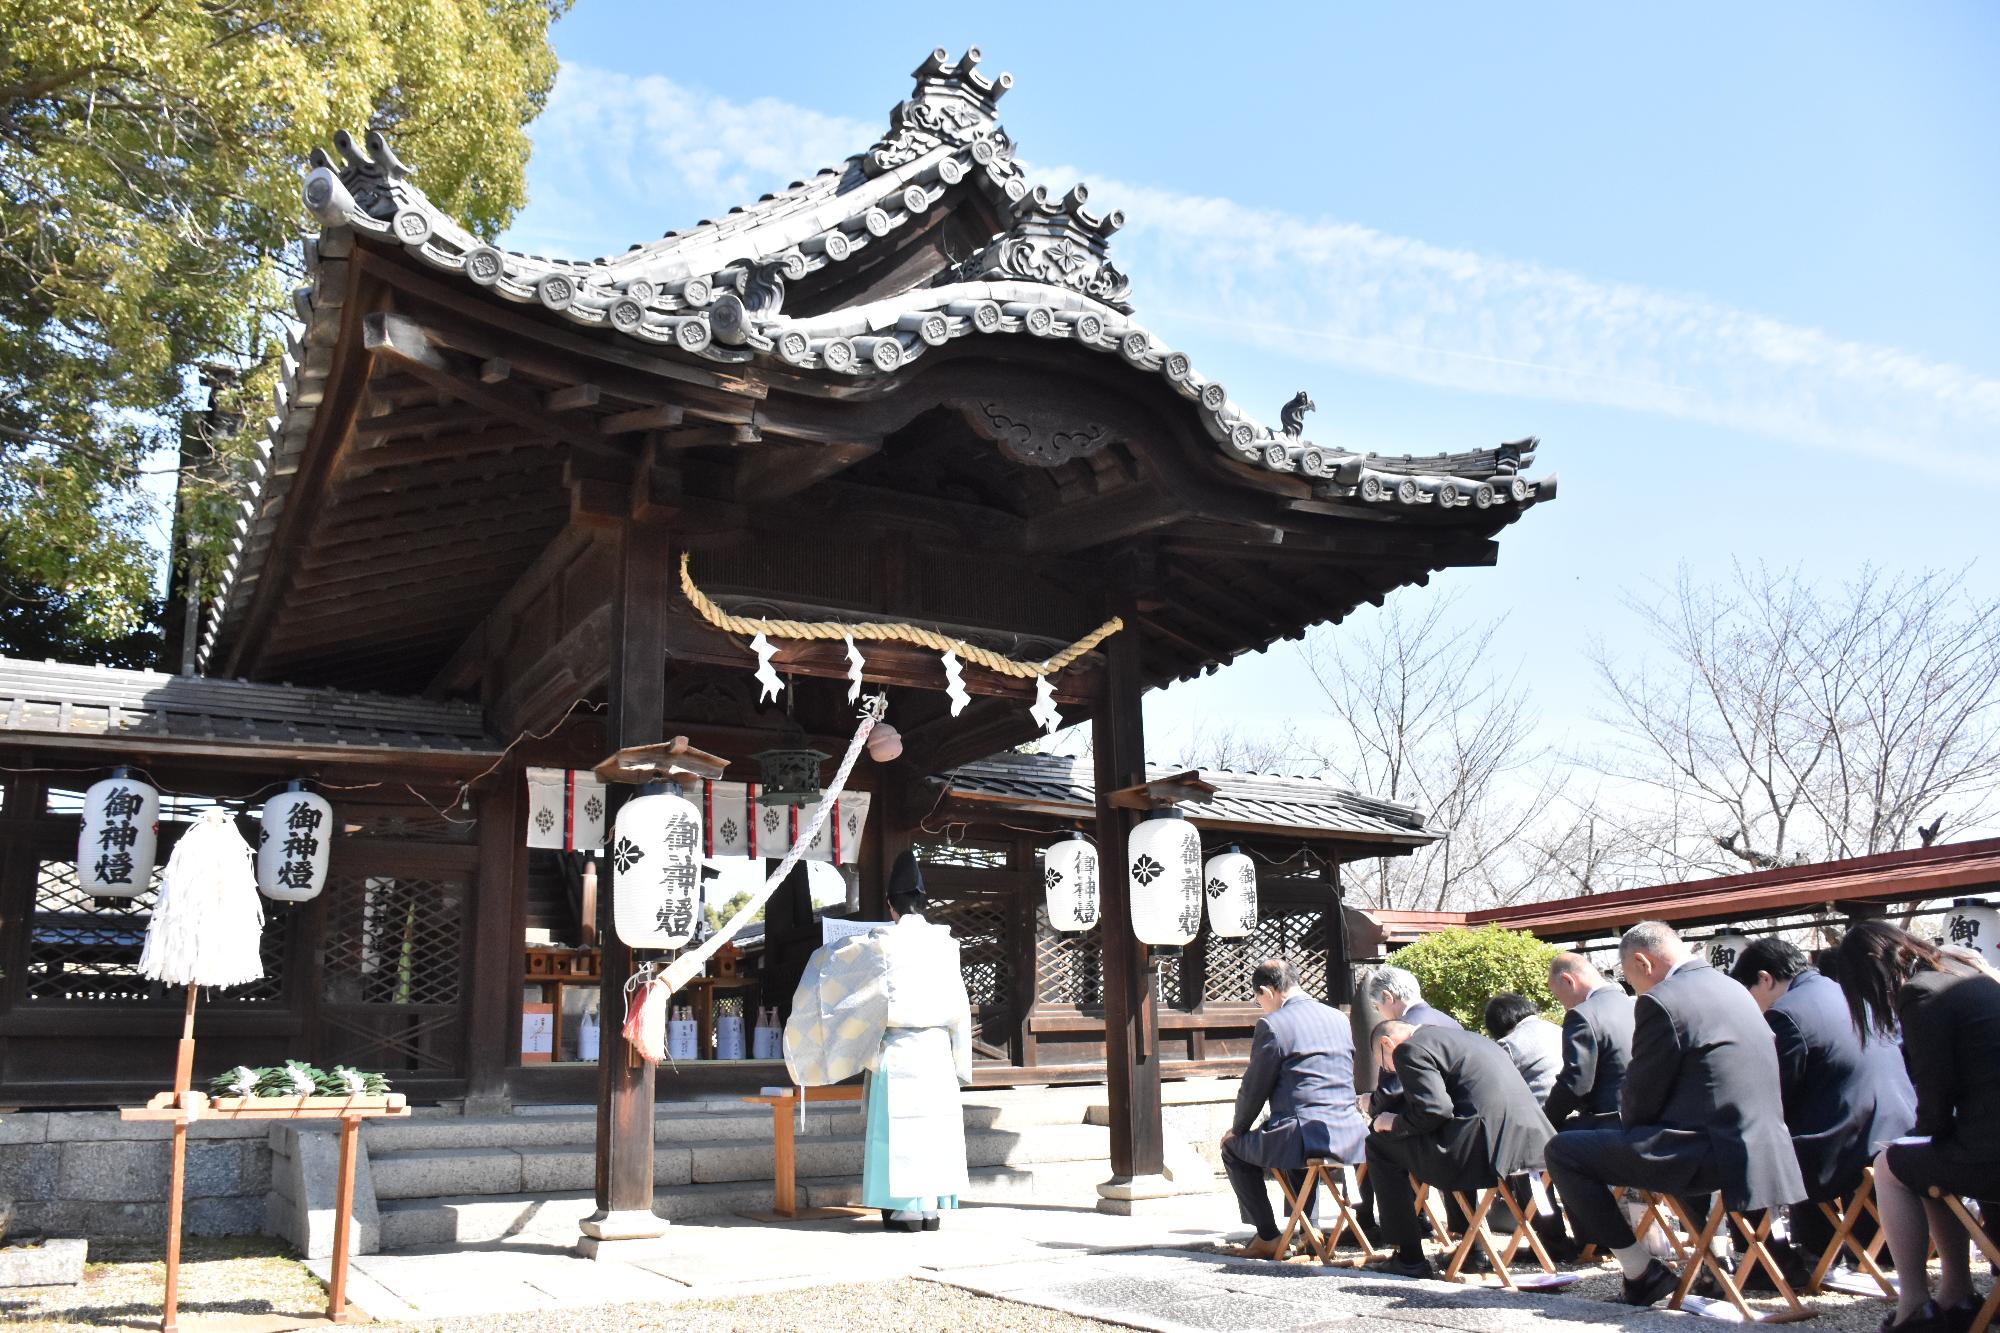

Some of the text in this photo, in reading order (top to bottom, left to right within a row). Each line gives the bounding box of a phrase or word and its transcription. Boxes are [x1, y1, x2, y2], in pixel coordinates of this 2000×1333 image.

[94, 786, 144, 885] 御神燈
[277, 801, 323, 890] 御神燈
[653, 811, 700, 939] 御神燈
[1073, 850, 1096, 924] 御神燈
[1177, 833, 1202, 936] 御神燈
[1238, 864, 1257, 931] 御神燈
[1710, 943, 1736, 975] 御
[1949, 914, 1982, 953] 御
